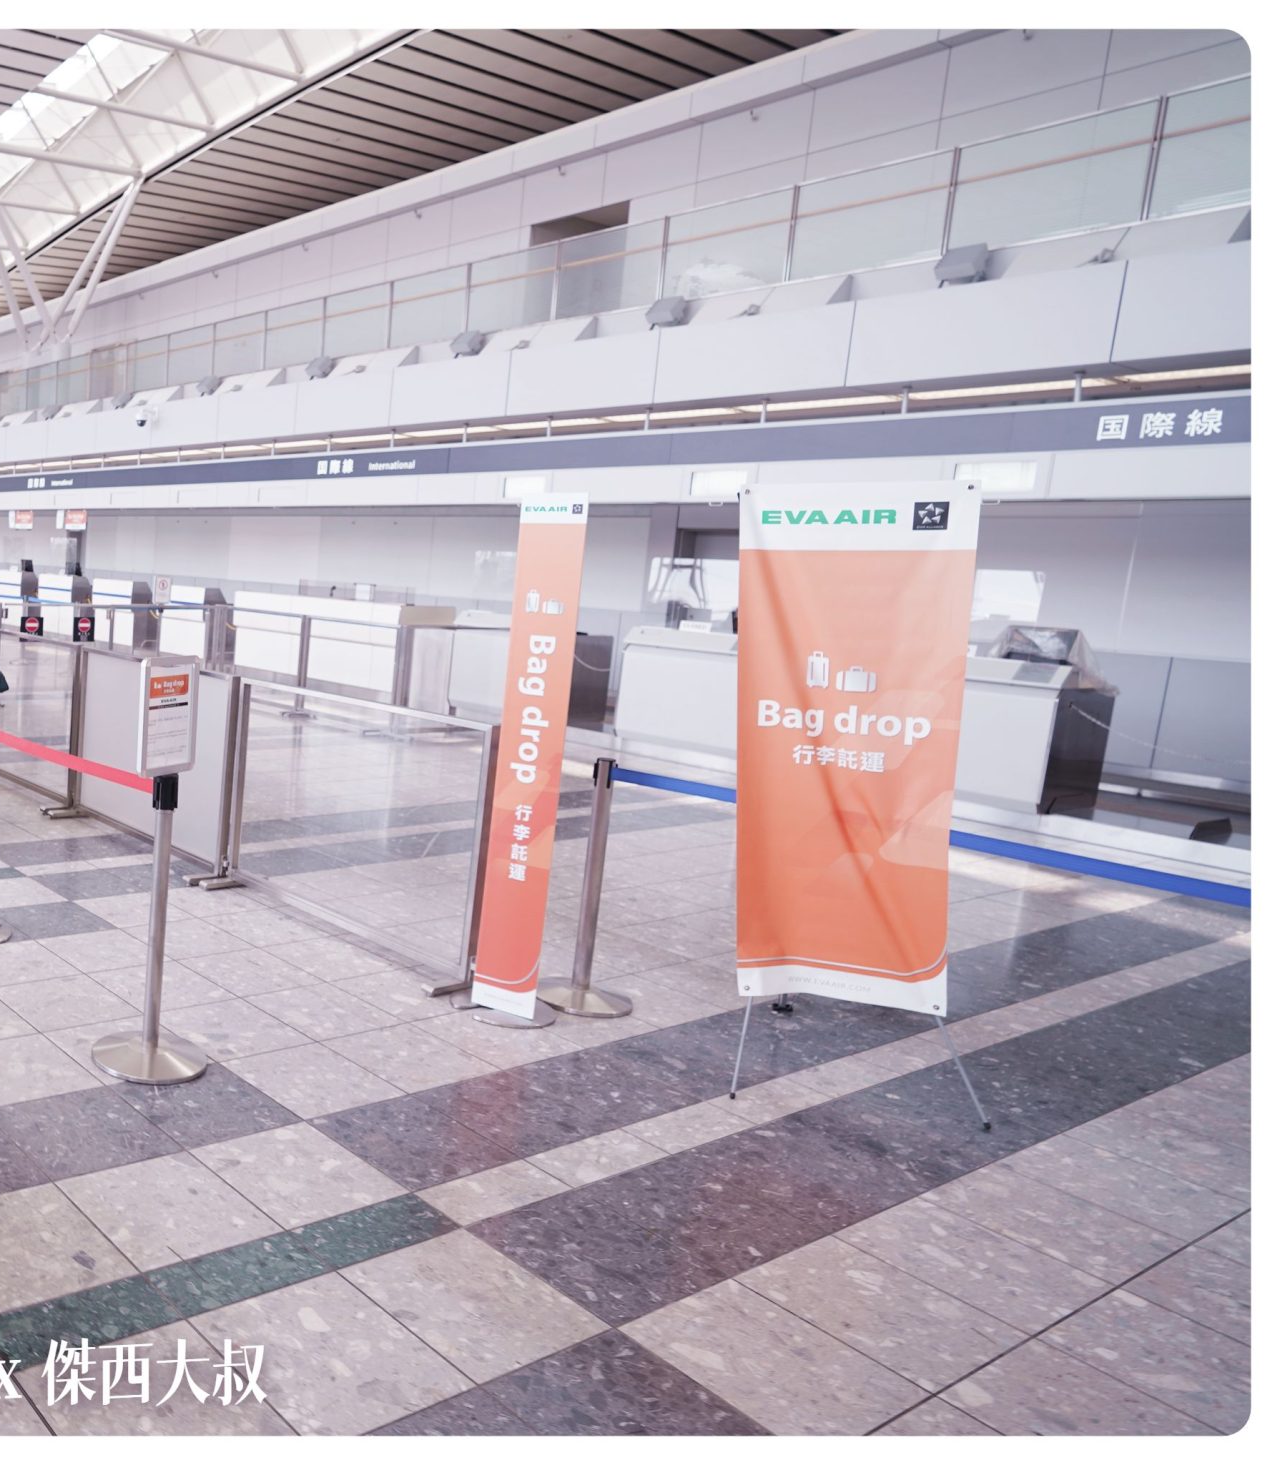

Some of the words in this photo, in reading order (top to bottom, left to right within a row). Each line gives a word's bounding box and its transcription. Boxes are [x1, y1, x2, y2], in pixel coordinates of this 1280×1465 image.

[1096, 408, 1223, 441] 国際線
[517, 633, 557, 697] Bag
[510, 705, 550, 785] drop
[757, 699, 824, 738] Bag
[834, 705, 932, 746] drop
[792, 744, 886, 773] 行李託運
[507, 804, 534, 883] 行李託運
